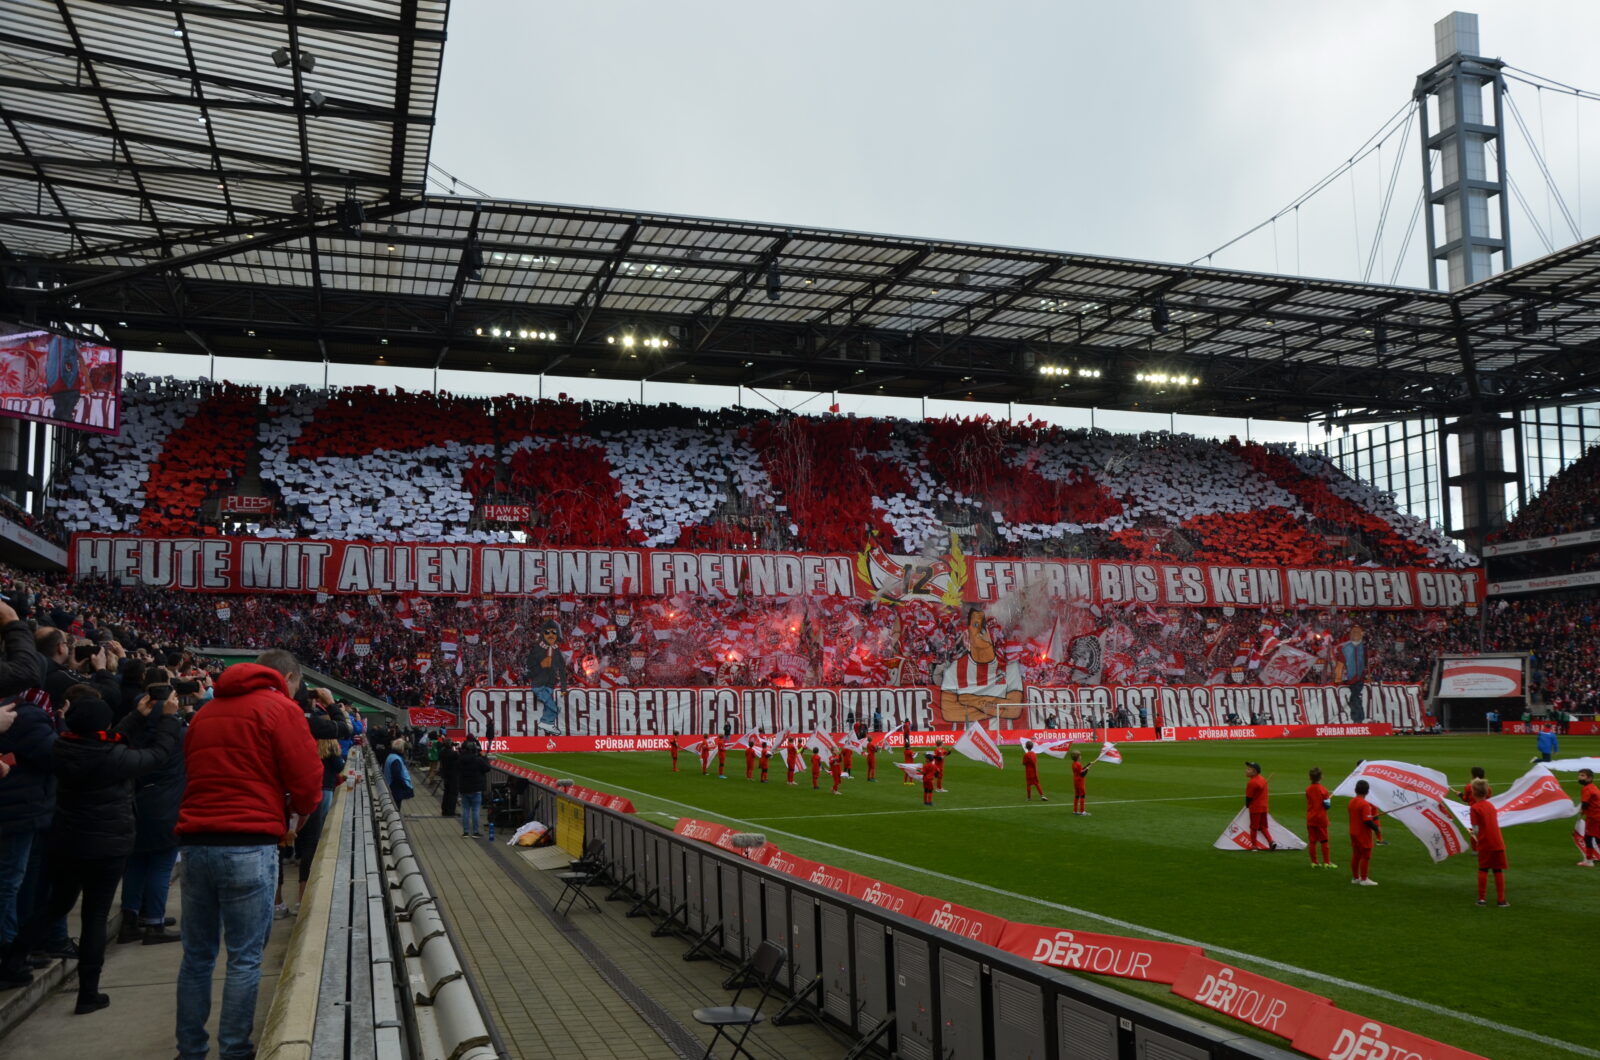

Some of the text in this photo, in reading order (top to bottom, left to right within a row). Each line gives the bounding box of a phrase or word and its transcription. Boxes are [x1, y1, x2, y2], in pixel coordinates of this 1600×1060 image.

[484, 505, 529, 519] HAWKS
[77, 538, 1478, 608] HEUTE MIT ALLEN MEINEN FREUNDEN FEIERN BIS ES KEIN MORGEN GIBT
[901, 563, 934, 595] 12
[466, 688, 933, 736] STEH ICH BEIM FC IN DER KURVE
[1028, 685, 1076, 730] DER
[1078, 686, 1114, 728] FC
[1115, 686, 1159, 728] IST
[1160, 686, 1213, 728] DAS
[1213, 685, 1300, 727] EINZIGE
[1302, 685, 1353, 726] WAS
[595, 738, 672, 750] SPÜRBAR ANDERS.
[889, 734, 924, 745] SPÜBAR
[1198, 727, 1256, 738] SPÜRBAR ANDERS.
[1316, 726, 1371, 736] SPÜRBAR ANDERS.
[929, 908, 983, 940] DERTOUR
[1032, 937, 1153, 979] DERTOUR
[1194, 973, 1288, 1031] DERTOUR
